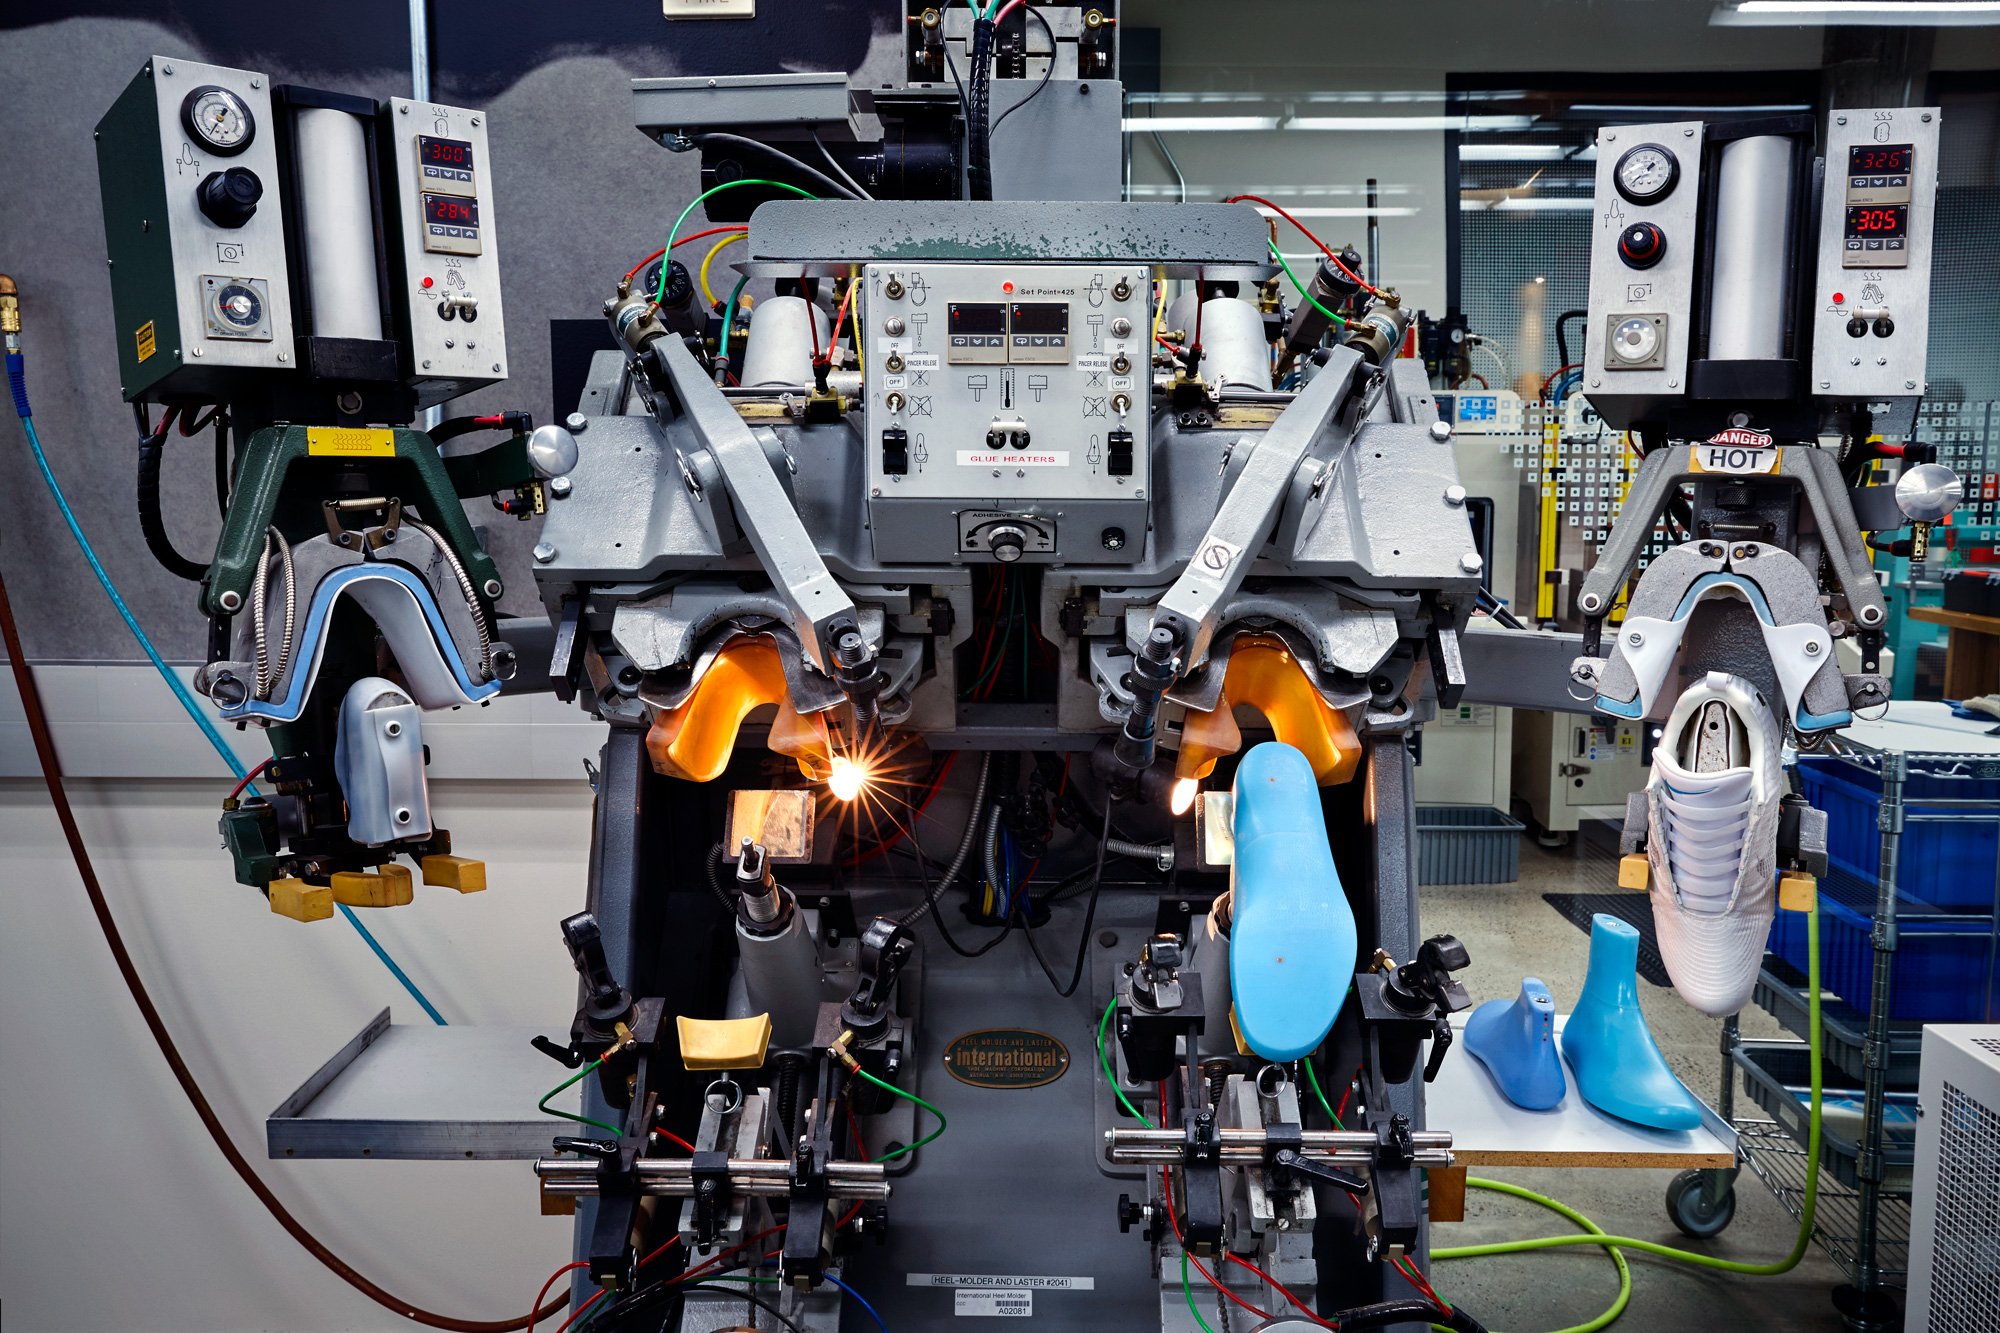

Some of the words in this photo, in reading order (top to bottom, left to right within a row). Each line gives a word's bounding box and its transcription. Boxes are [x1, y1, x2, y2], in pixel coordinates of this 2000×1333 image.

[433, 144, 462, 162] 300
[1864, 152, 1900, 168] 326
[437, 202, 468, 219] 284
[1857, 210, 1896, 230] 305
[1709, 449, 1763, 468] HOT
[957, 1048, 1056, 1067] international
[934, 1277, 994, 1285] HEEL-MOLDER
